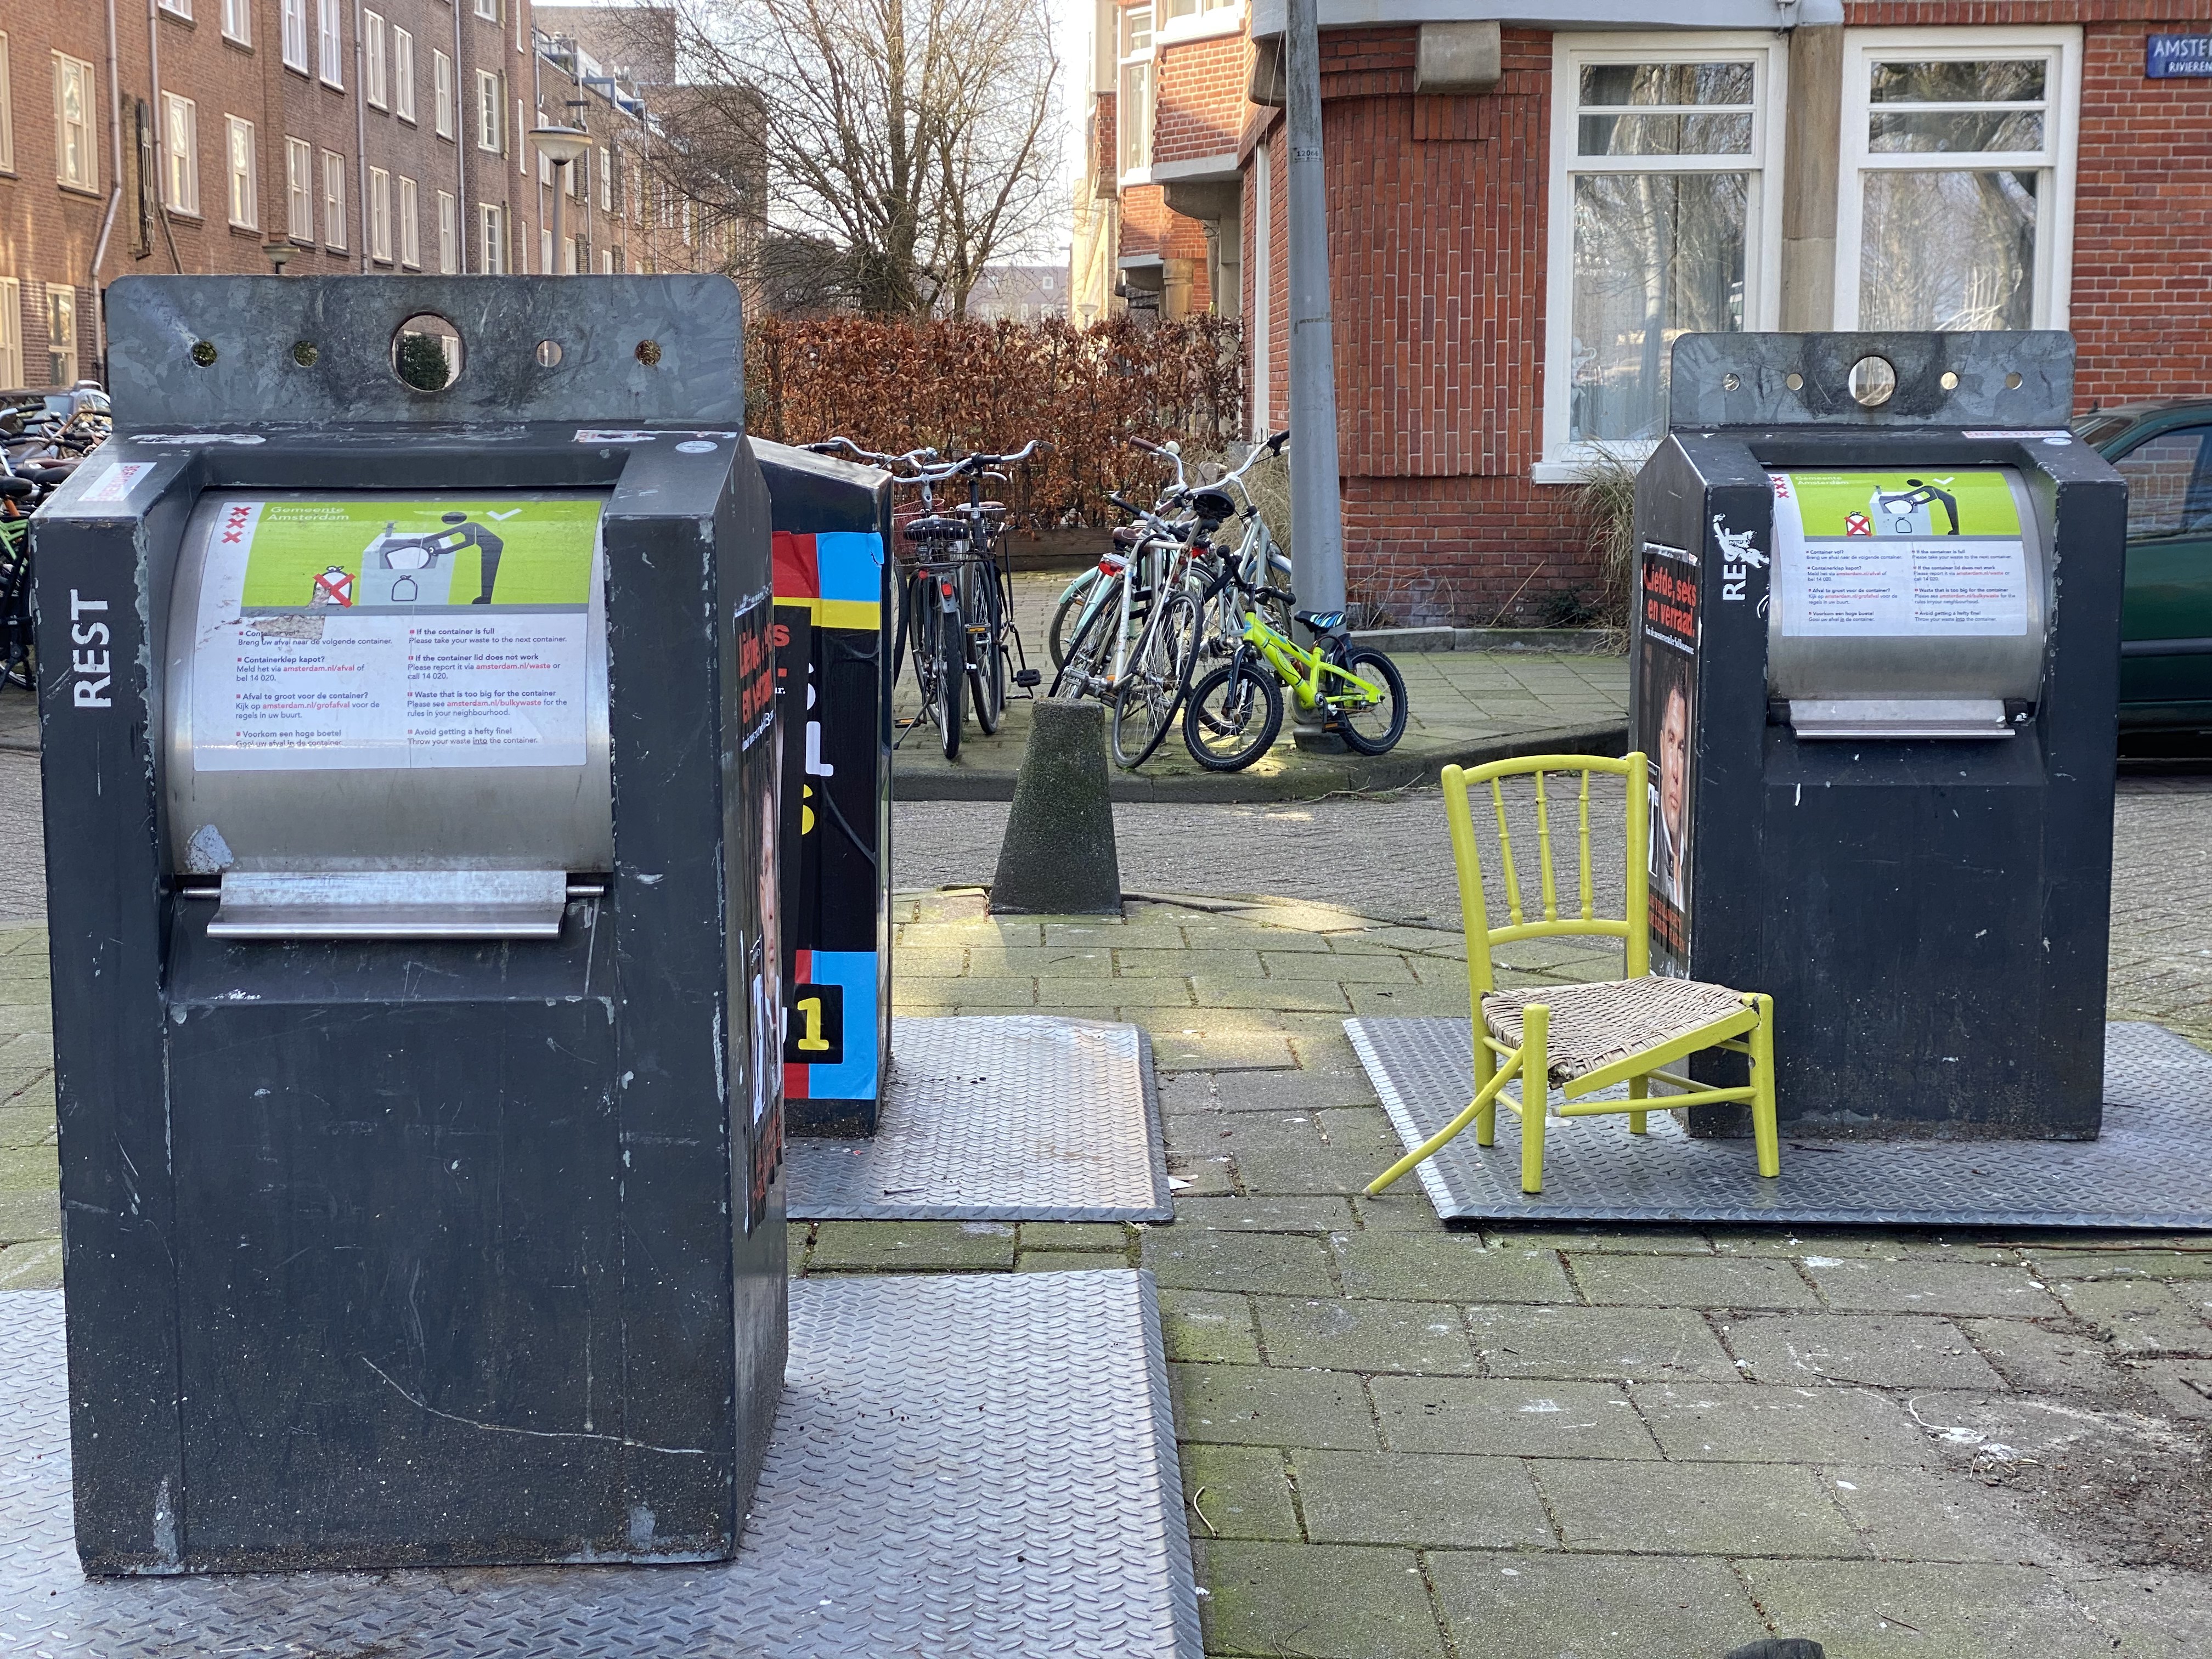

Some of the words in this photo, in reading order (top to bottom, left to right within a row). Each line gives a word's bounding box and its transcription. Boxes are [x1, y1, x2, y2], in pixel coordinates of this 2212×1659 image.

[2154, 39, 2212, 57] AMSTE
[1677, 576, 1696, 607] seks
[1648, 599, 1658, 622] en
[1661, 602, 1695, 637] verraad.
[323, 637, 356, 646] volgende
[70, 589, 111, 707] REST
[300, 656, 325, 664] kapot?
[236, 702, 249, 711] Kijk
[263, 702, 350, 710] amsterdam.nl/grofafval
[447, 699, 541, 708] amsterdam.nl/bulkywaste
[236, 712, 258, 720] regels
[453, 709, 510, 717] neighbourhood.
[295, 730, 314, 738] hoge
[439, 728, 466, 736] getting
